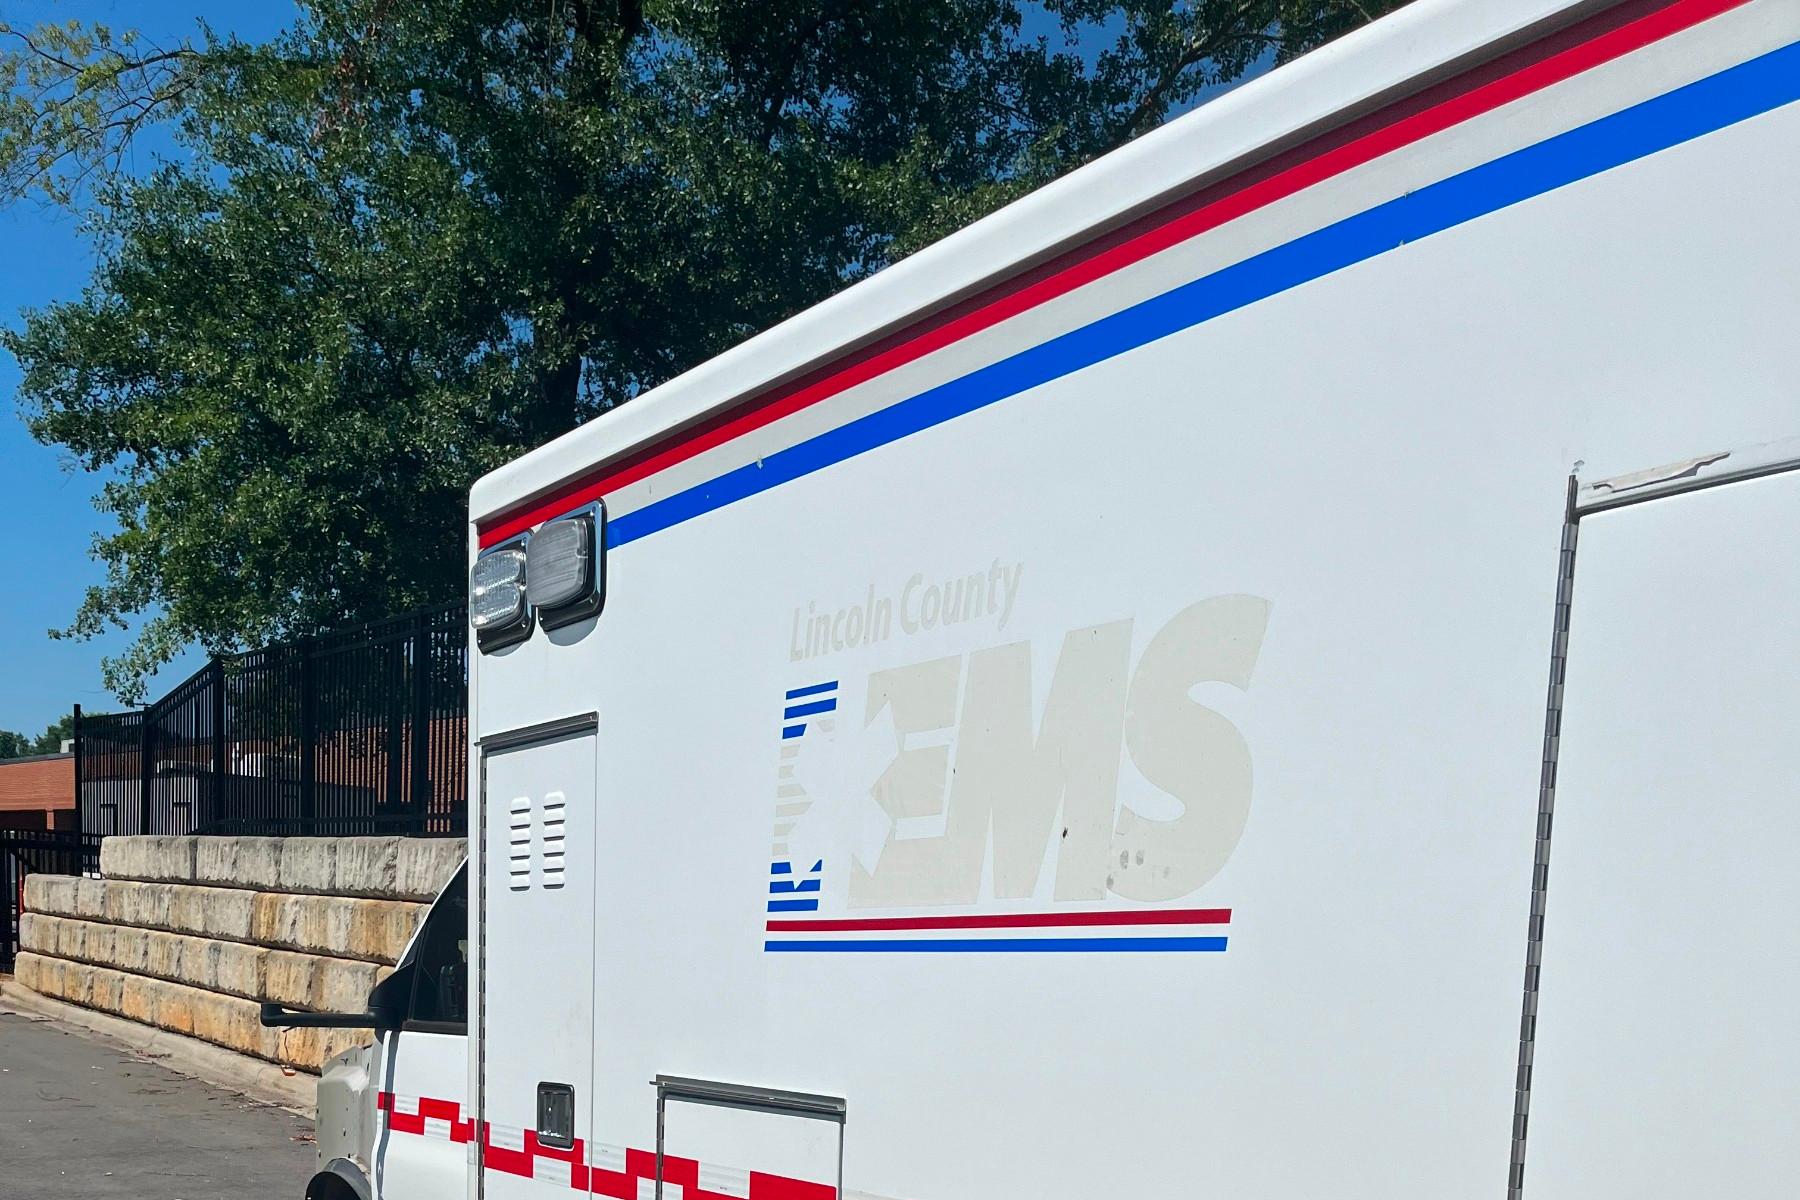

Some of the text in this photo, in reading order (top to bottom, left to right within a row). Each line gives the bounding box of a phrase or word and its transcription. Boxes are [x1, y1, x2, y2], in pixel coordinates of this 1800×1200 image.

[790, 558, 1024, 661] Lincoln County
[847, 593, 1274, 909] EMS
